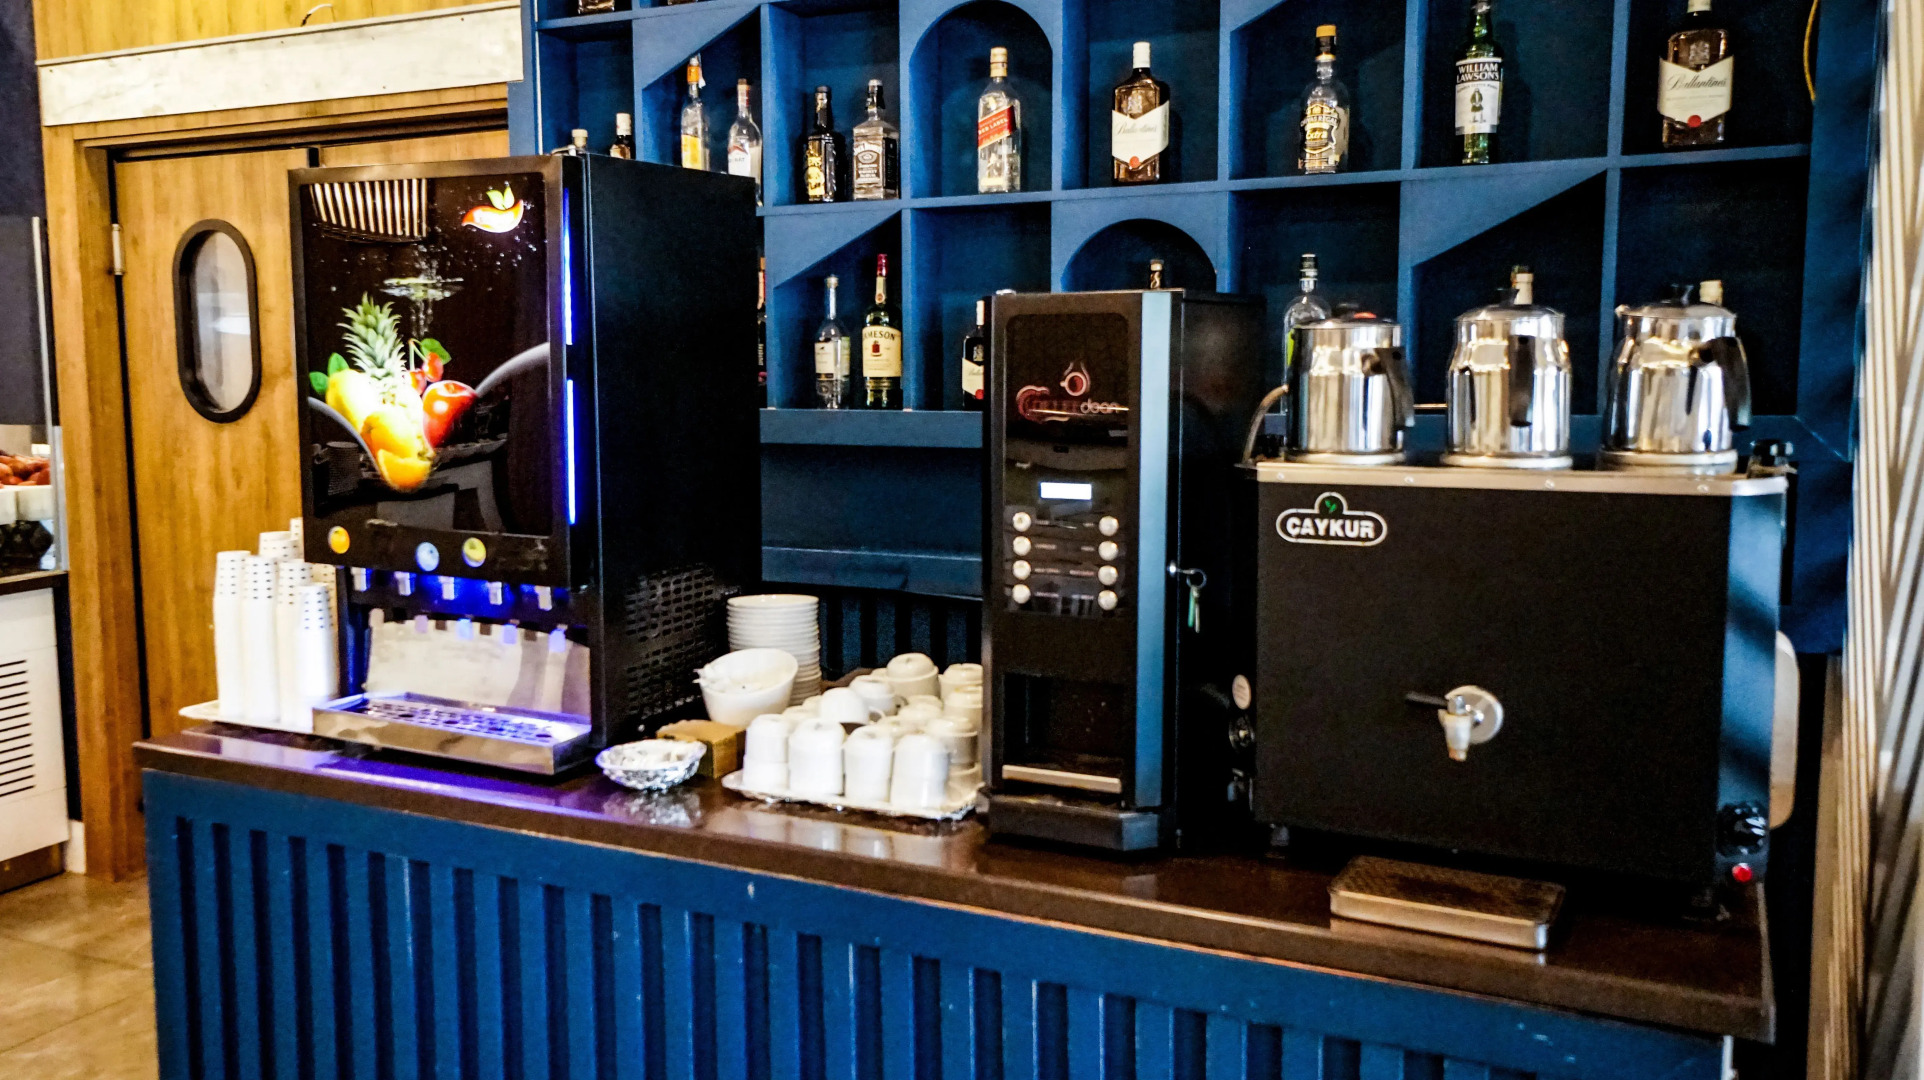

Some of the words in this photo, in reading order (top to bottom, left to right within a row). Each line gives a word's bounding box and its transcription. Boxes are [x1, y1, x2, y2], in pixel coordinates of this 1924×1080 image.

[1459, 63, 1498, 73] WILLIAM
[1457, 72, 1499, 83] LAWSON'S
[990, 117, 1009, 130] LABEL
